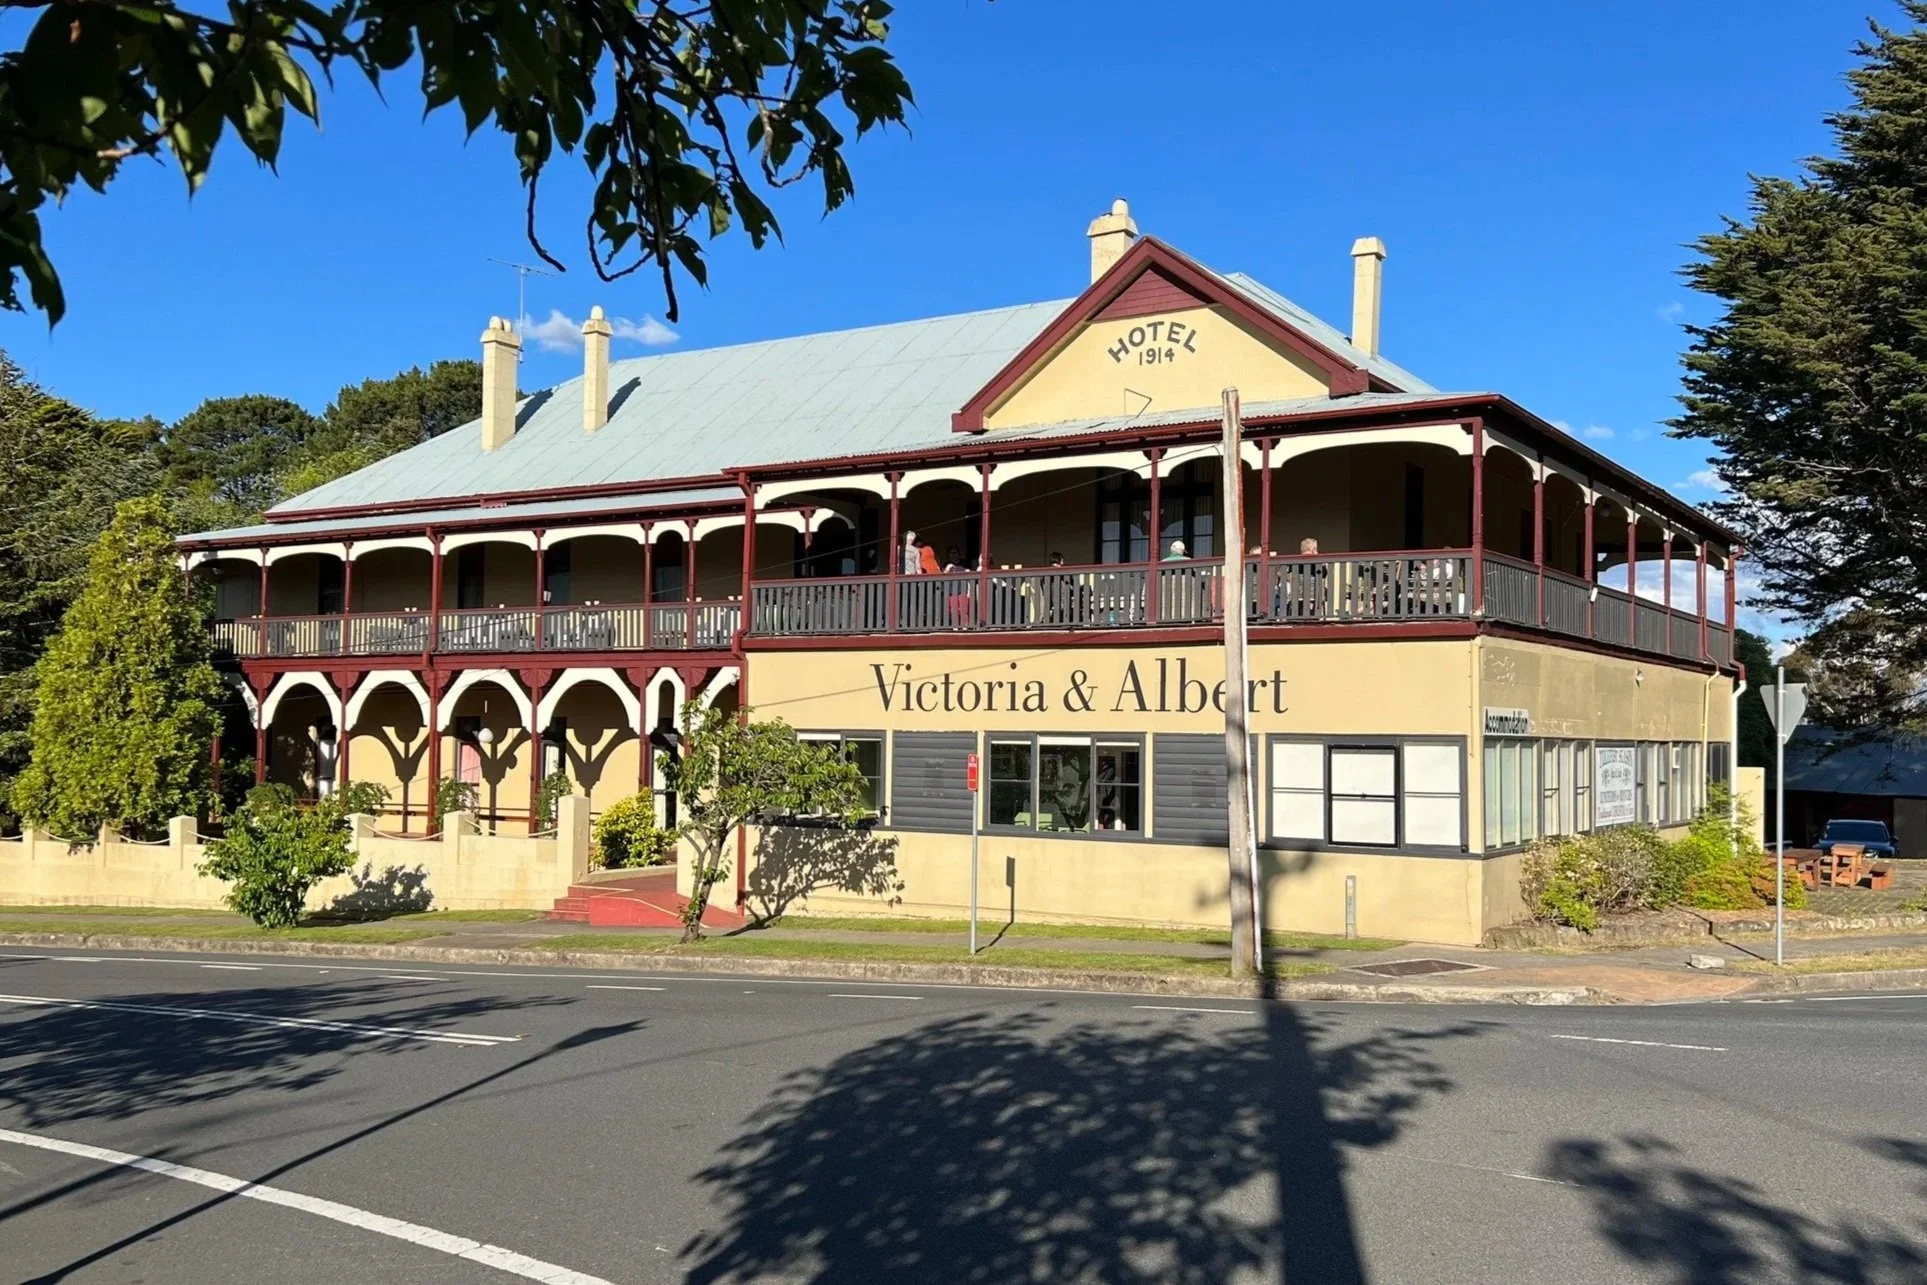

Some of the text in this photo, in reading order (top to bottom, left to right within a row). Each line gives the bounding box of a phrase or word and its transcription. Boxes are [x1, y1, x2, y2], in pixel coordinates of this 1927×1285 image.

[1107, 321, 1197, 363] HOTEL
[1139, 347, 1175, 366] 1914
[869, 662, 1048, 712] Victoria
[1062, 669, 1099, 712] &
